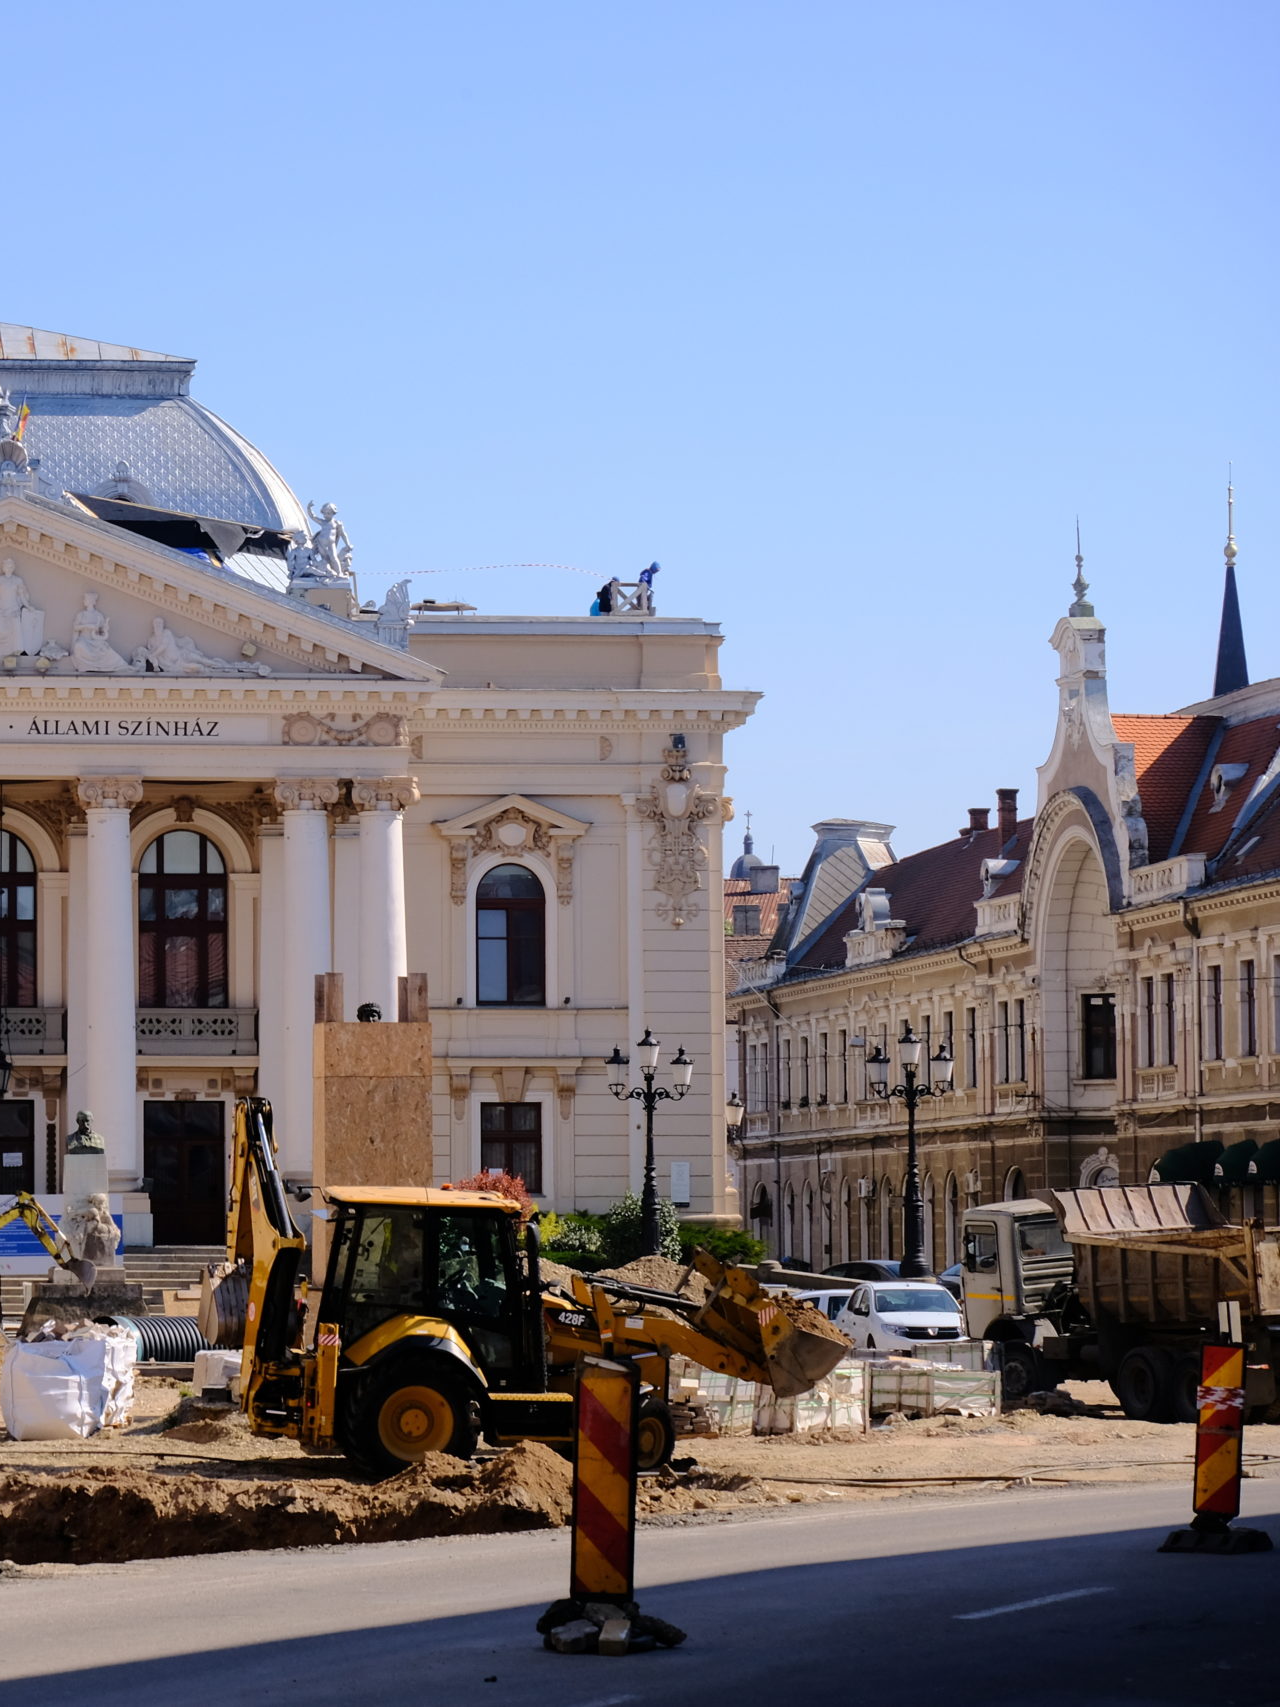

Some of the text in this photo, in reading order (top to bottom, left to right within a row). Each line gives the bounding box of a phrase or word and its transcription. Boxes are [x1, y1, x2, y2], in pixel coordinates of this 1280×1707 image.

[26, 715, 110, 736] ÁLLAMI
[117, 716, 220, 737] SZÍNHÁZ
[558, 1311, 586, 1326] 428F
